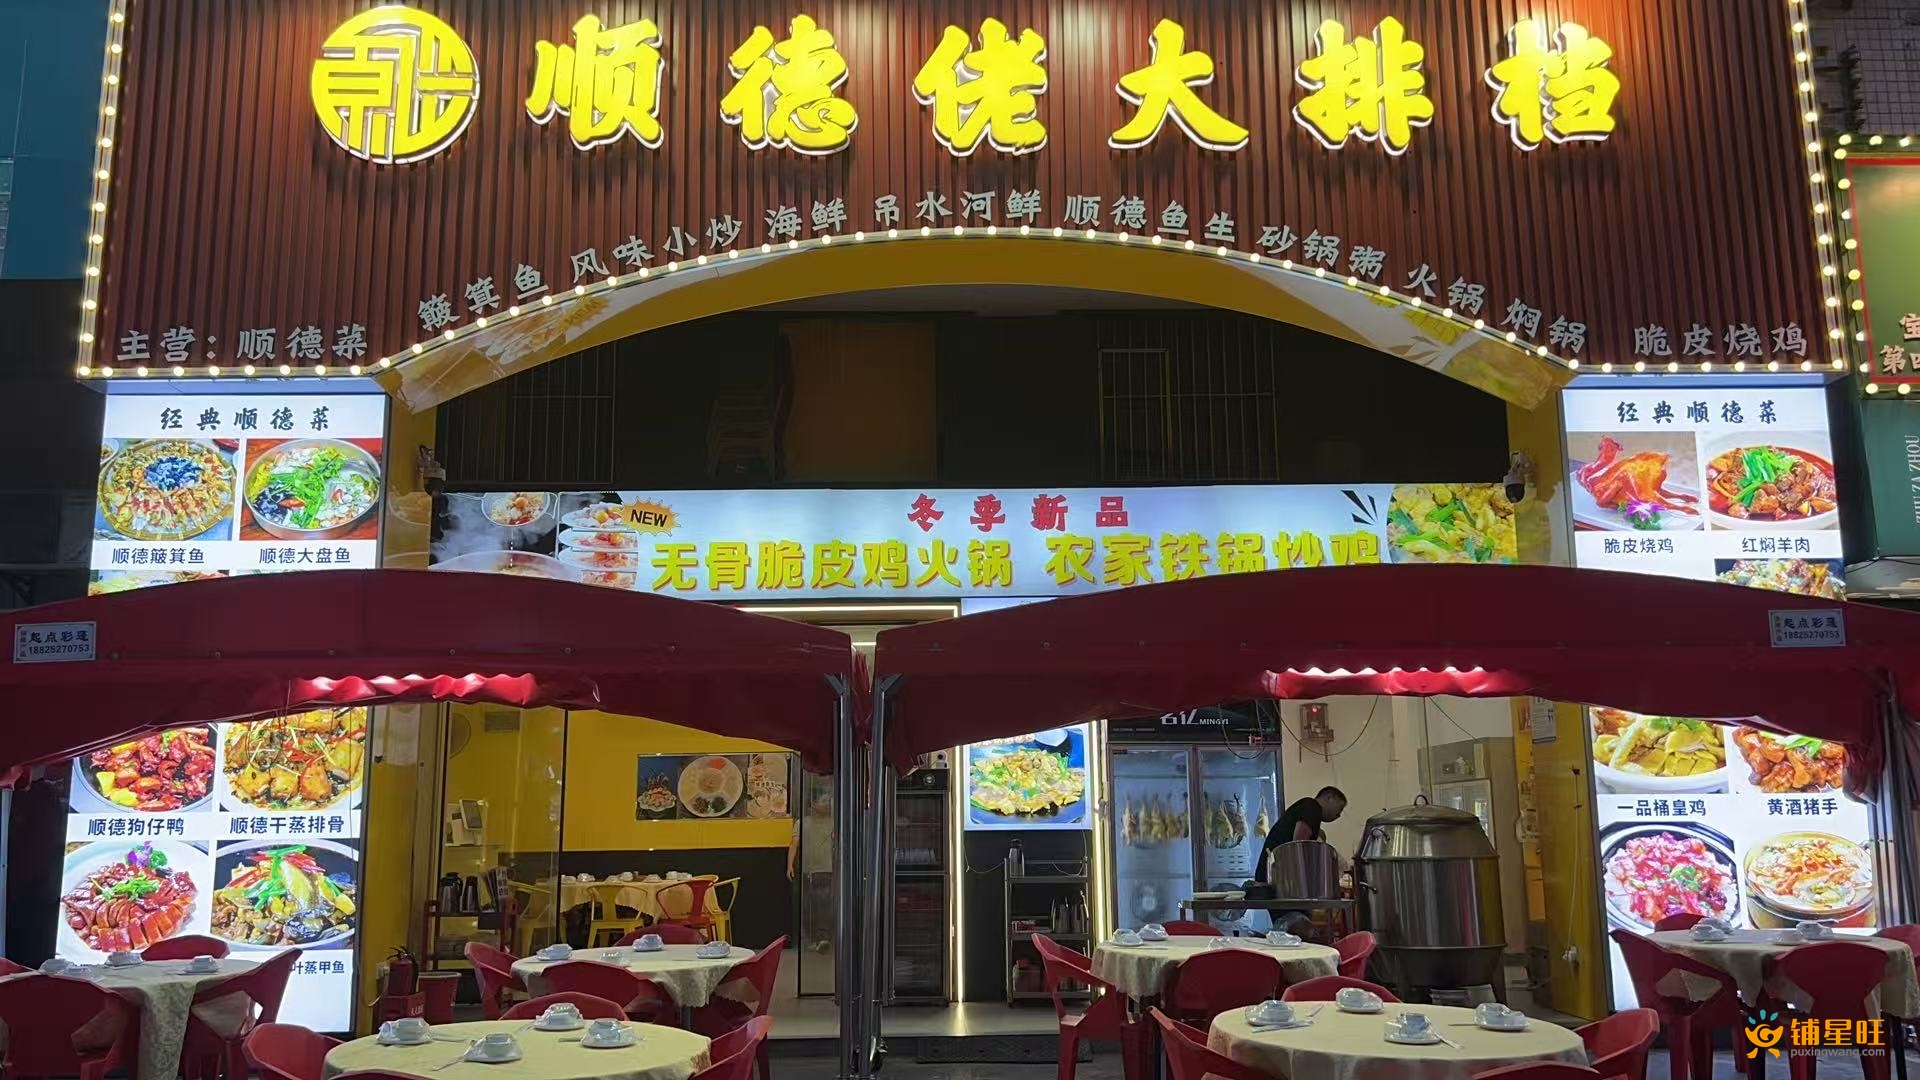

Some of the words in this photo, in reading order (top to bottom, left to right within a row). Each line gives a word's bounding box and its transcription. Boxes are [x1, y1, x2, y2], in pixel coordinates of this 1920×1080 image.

[526, 14, 1620, 156] 顺德佬大排档
[236, 324, 368, 360] 顺德菜
[417, 263, 549, 332] 簸箕鱼
[570, 214, 743, 283] 风味小炒
[764, 197, 848, 239] 海鲜
[874, 188, 1042, 226] 吊水河鲜
[1064, 194, 1235, 243] 顺德鱼生
[1256, 225, 1386, 280] 砂锅粥
[1402, 263, 1487, 315] 火锅
[1501, 298, 1587, 354] 焖锅
[1633, 322, 1808, 357] 脆皮烧鸡
[161, 406, 330, 431] 经典顺德菜
[1617, 400, 1778, 425] 经典顺德菜
[630, 509, 668, 528] NEW
[907, 493, 1129, 532] 冬季新品
[1604, 537, 1674, 554] 脆皮烧鸡
[1742, 537, 1811, 554] 红焖羊肉
[112, 547, 205, 565] 顺德簸箕鱼
[259, 547, 351, 564] 顺德大盘鱼
[651, 538, 1014, 592] 无骨脆皮鸡火锅
[1044, 531, 1382, 586] 农家铁锅炒鸡
[1617, 799, 1706, 816] 一品桶皇鸡
[1767, 798, 1838, 815] 黄酒猪手
[88, 817, 185, 836] 顺德狗仔鸭
[230, 816, 345, 835] 顺德干蒸排骨
